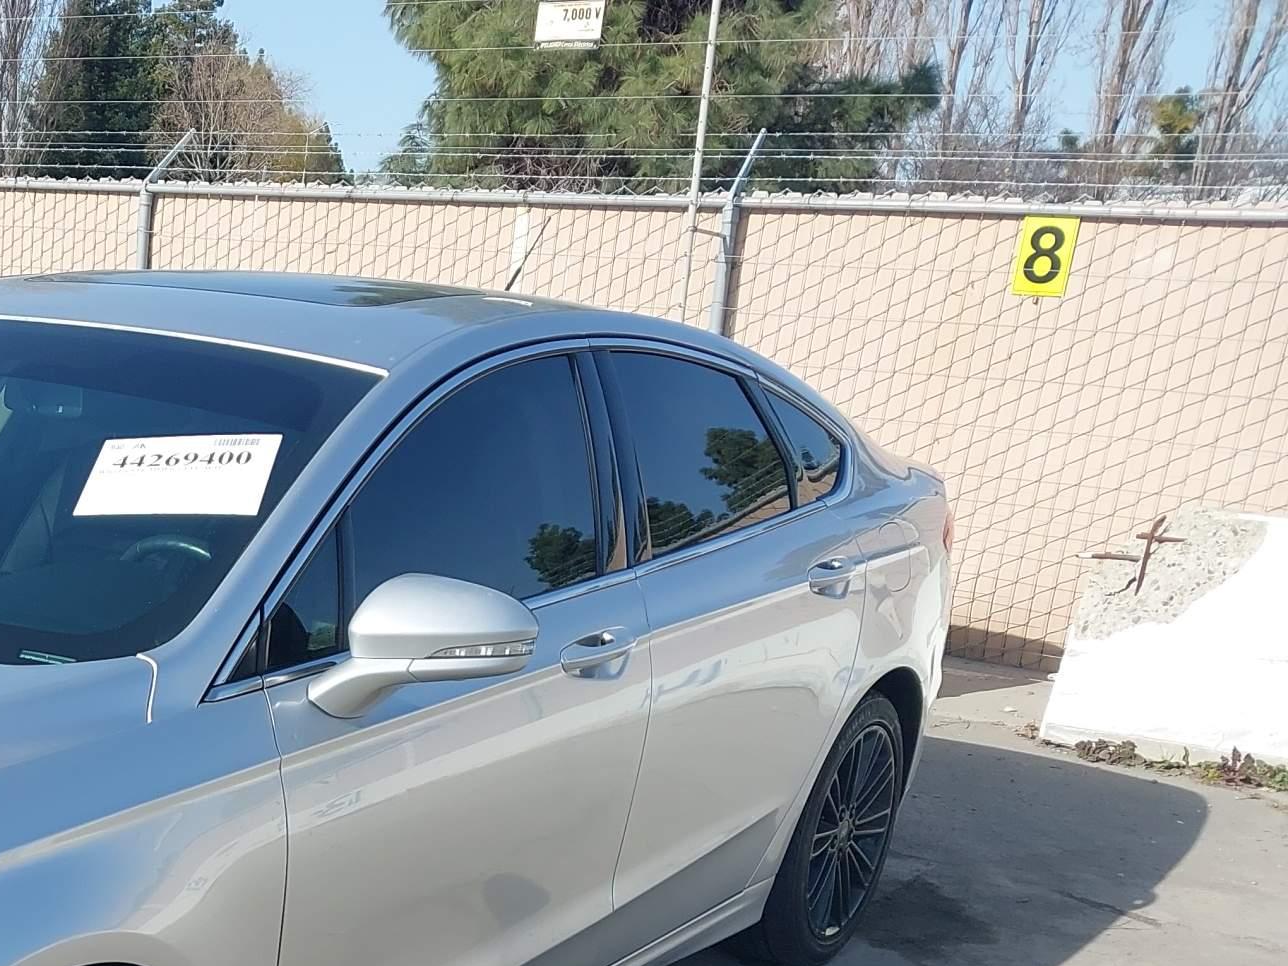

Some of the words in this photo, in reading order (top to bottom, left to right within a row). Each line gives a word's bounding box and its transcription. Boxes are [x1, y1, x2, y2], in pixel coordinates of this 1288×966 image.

[563, 8, 592, 22] 7,000
[595, 7, 601, 19] V
[1022, 225, 1066, 285] 8
[112, 450, 252, 468] 44269400
